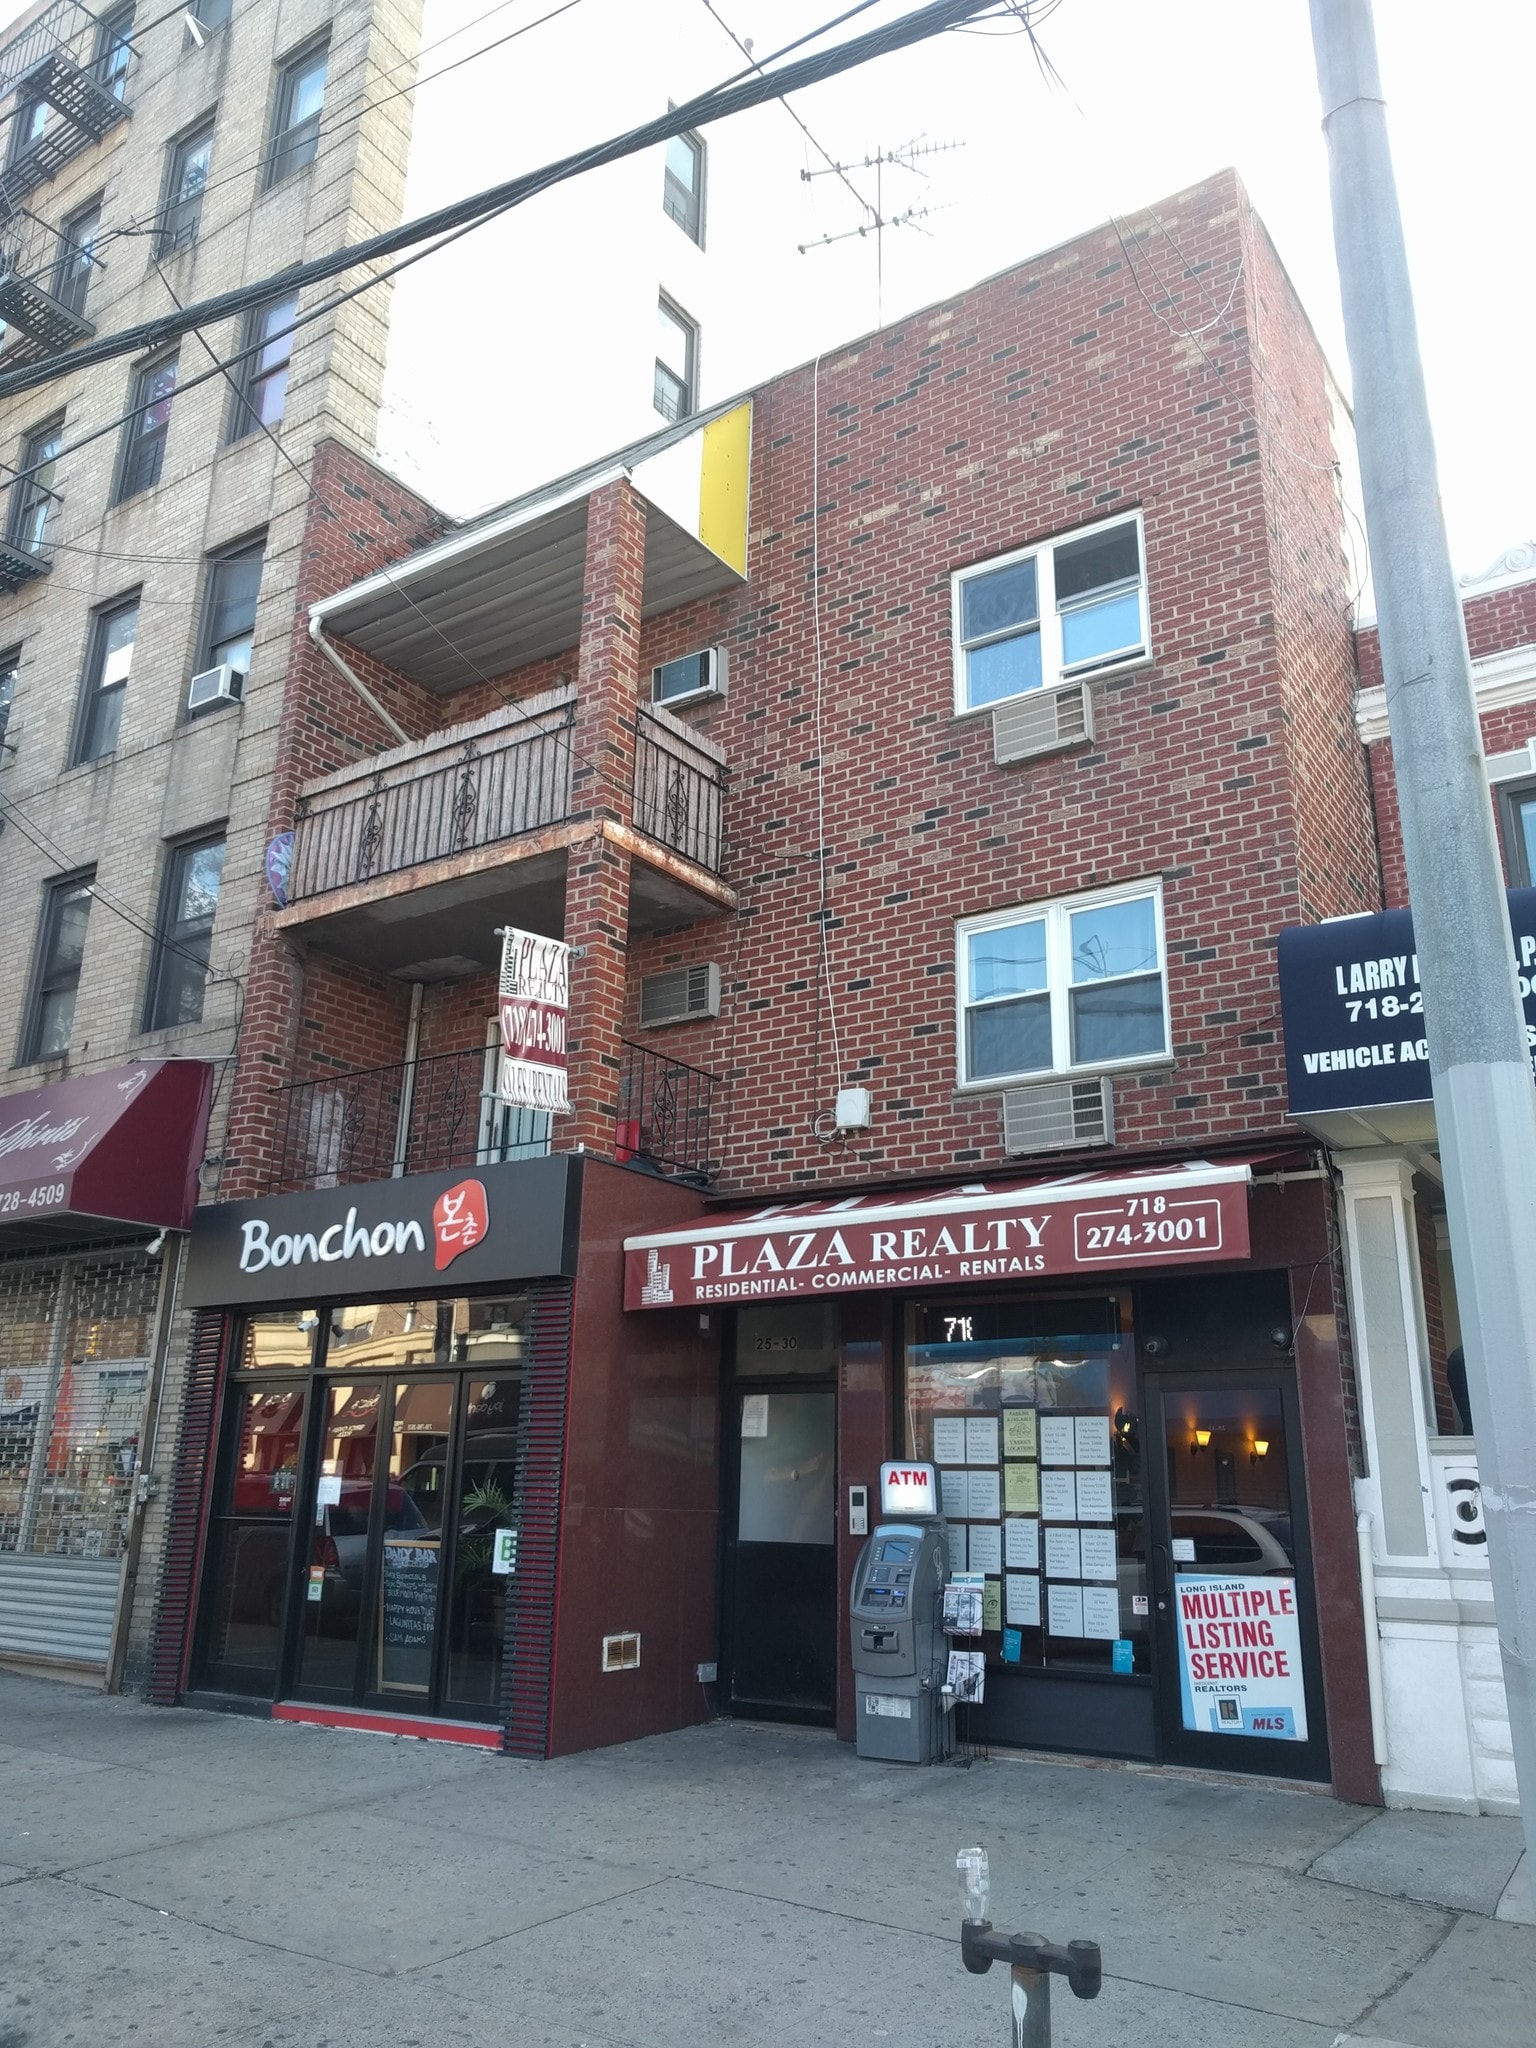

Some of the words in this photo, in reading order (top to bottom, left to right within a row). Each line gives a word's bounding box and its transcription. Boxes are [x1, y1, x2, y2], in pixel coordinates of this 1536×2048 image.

[518, 936, 569, 989] PLAZA
[1335, 955, 1408, 996] LARRY
[518, 977, 568, 1005] REALTY
[1303, 1043, 1396, 1075] VEHICLE
[440, 1189, 479, 1246] 본촌
[1126, 1196, 1166, 1217] 718
[240, 1206, 426, 1273] Bonchon
[690, 1230, 854, 1280] PLAZA
[869, 1214, 1052, 1263] REALTY
[1086, 1216, 1208, 1250] 274-3001
[695, 1279, 805, 1300] RESIDENTIAL-
[812, 1267, 951, 1289] COMMERCIAL-
[960, 1254, 1045, 1277] RENTALS
[755, 1336, 798, 1350] 25-30
[888, 1471, 928, 1486] ATM
[385, 1546, 413, 1560] DAILY
[414, 1548, 438, 1564] BAR
[1180, 1585, 1207, 1593] LONG
[1209, 1583, 1245, 1592] ISLAND
[1182, 1589, 1295, 1620] MULTIPLE
[1186, 1620, 1275, 1650] LISTING
[1191, 1650, 1291, 1680] SERVICE
[1194, 1685, 1248, 1693] REALTORS
[1252, 1717, 1285, 1731] MLS
